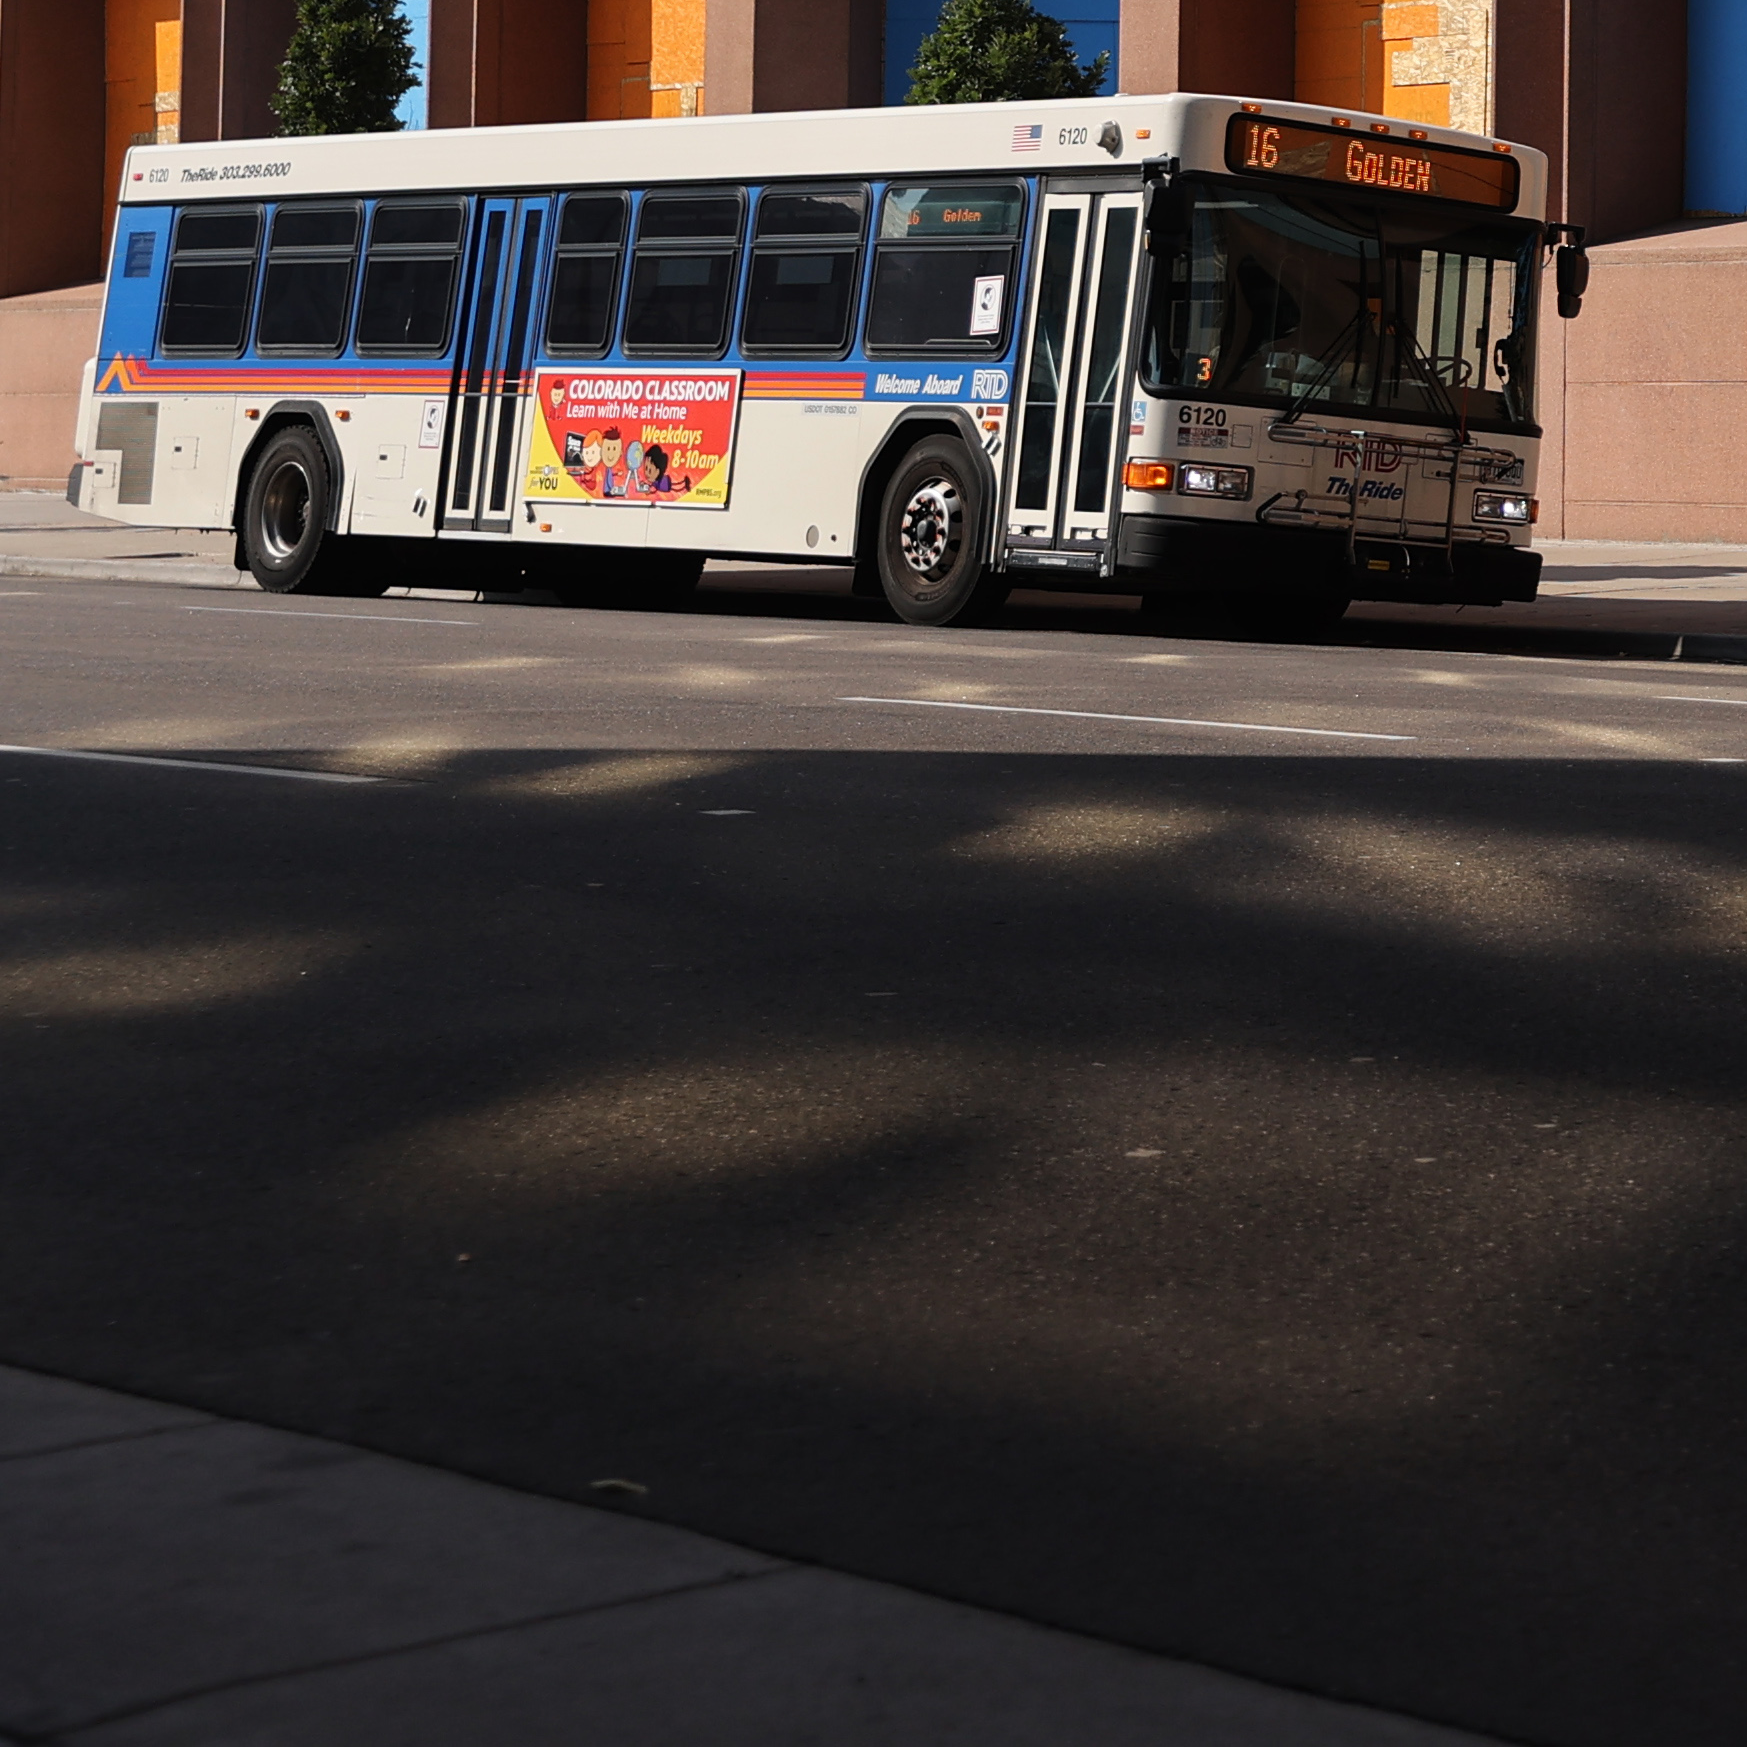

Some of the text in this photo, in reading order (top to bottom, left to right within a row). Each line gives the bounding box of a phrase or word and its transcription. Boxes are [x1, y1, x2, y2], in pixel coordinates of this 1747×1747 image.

[1058, 127, 1088, 146] 6120
[1246, 124, 1281, 168] 16
[149, 168, 169, 183] 6120
[180, 161, 292, 183] TheRide 303.299.6000
[942, 209, 983, 223] Golden
[1197, 357, 1211, 381] 3
[569, 379, 730, 401] COLORADO CLASSROOM
[874, 373, 964, 395] Welcome Aboard
[971, 369, 1009, 399] RTD
[566, 402, 688, 420] Learn with Me at Home
[1178, 405, 1227, 427] 6120
[641, 424, 703, 449] Weekdays
[671, 449, 719, 469] 8-10am
[539, 476, 559, 491] YOU
